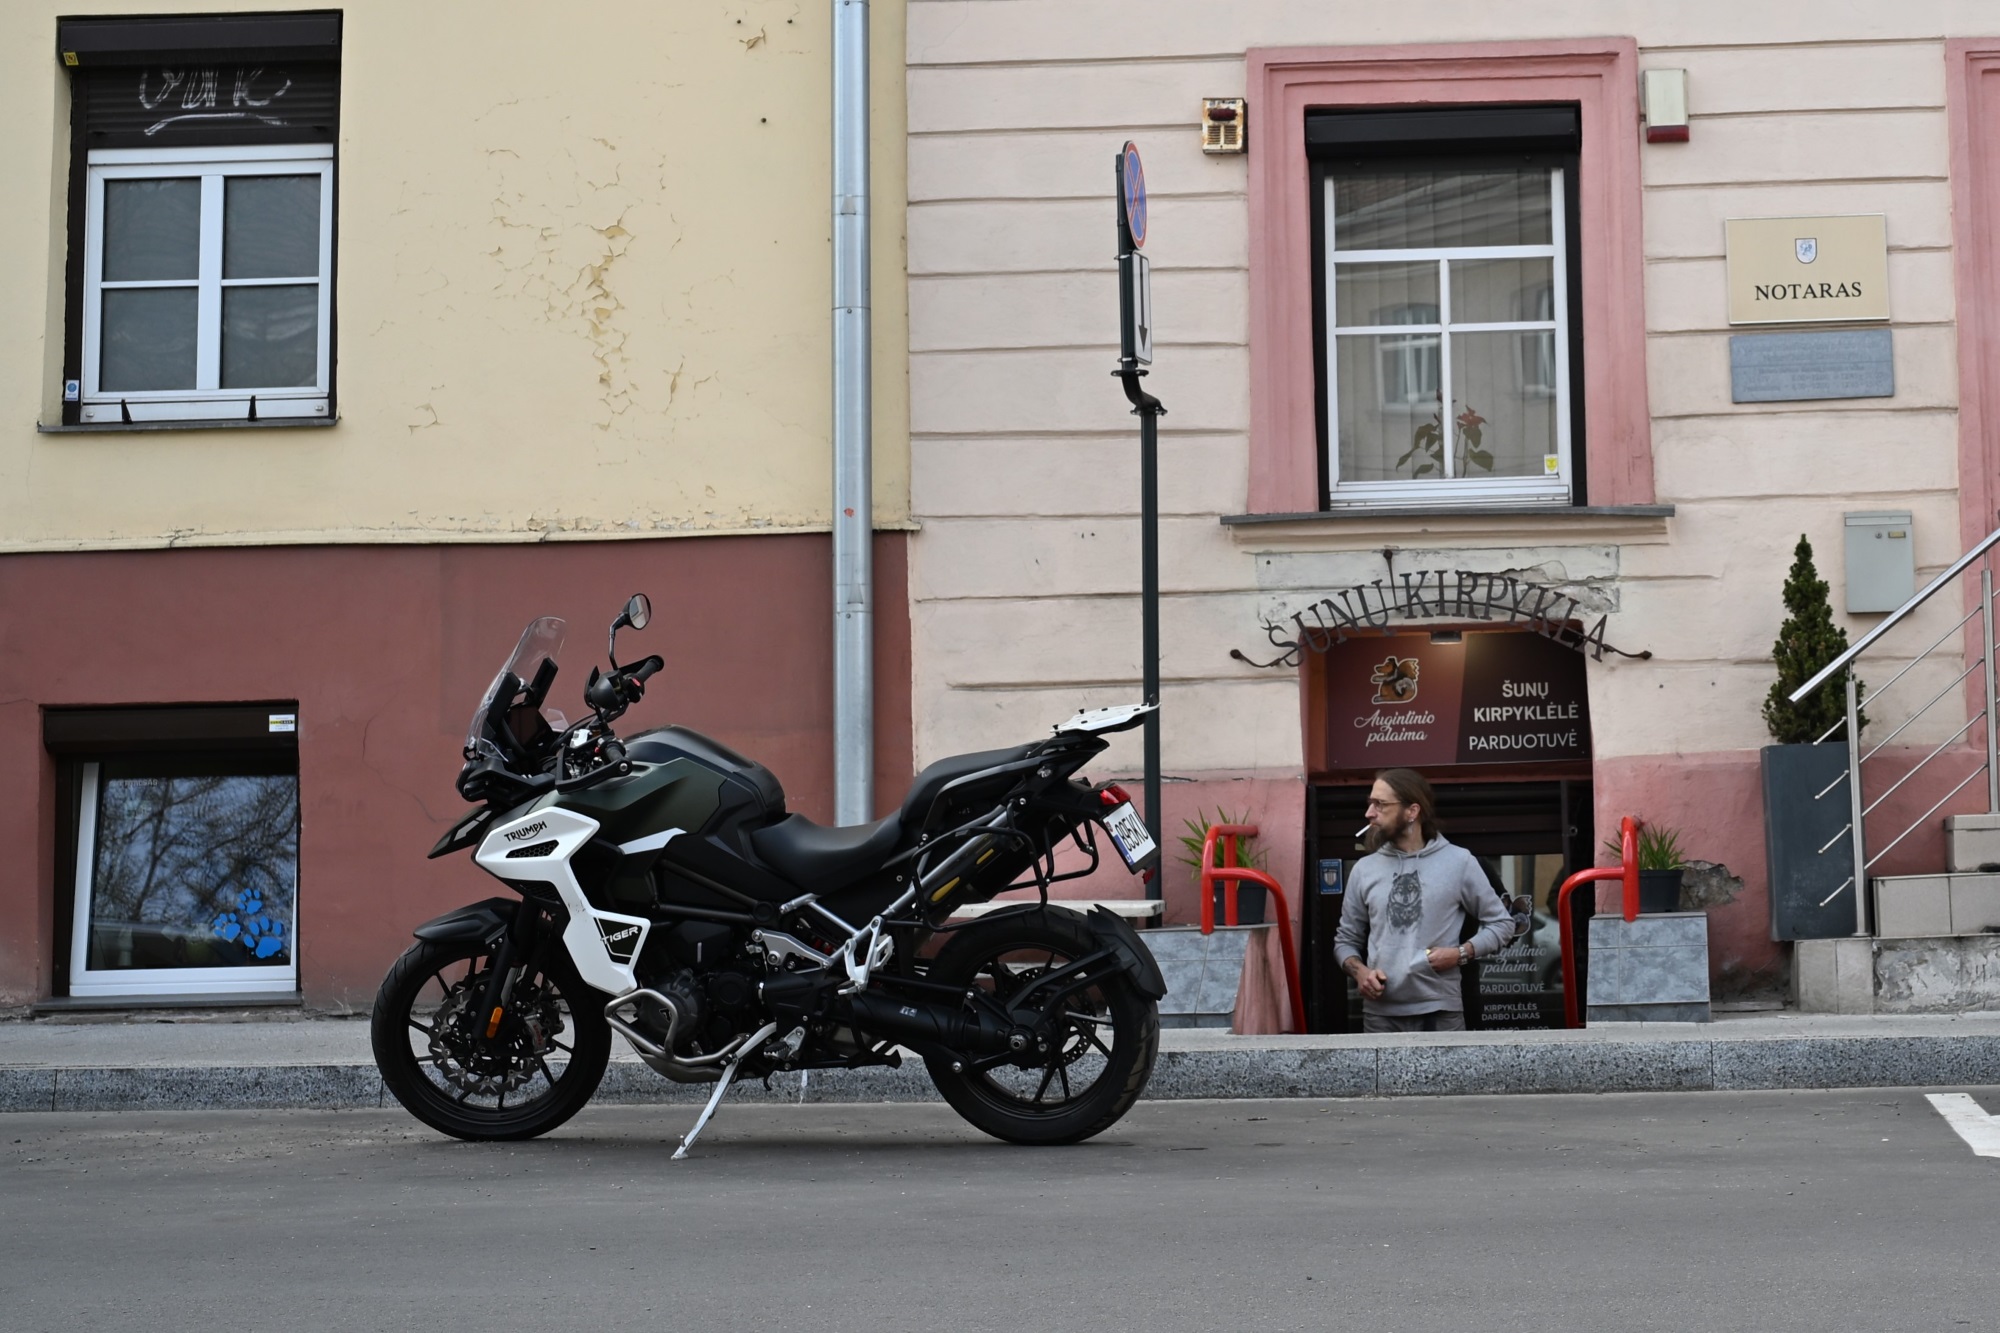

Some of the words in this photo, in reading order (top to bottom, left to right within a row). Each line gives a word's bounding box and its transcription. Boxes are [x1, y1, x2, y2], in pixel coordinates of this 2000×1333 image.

[1754, 281, 1862, 301] NOTARAS
[1399, 569, 1608, 663] KIRPYKLA
[1502, 680, 1549, 700] ŠUNŲ
[1354, 709, 1435, 732] Augintinio
[1474, 701, 1579, 722] KIRPYKLĖLĖ
[1365, 727, 1428, 747] palaima
[1469, 728, 1578, 751] PARDUOTUVĖ
[504, 820, 547, 842] TRIUMPH
[600, 926, 639, 945] TIGER
[1482, 960, 1539, 978] palaima
[1480, 981, 1546, 994] PARDUOTUVĖ
[1481, 1013, 1510, 1021] DARBO
[1511, 1012, 1541, 1020] LAIKAS
[1484, 1002, 1538, 1012] KIRPYKLĖLĖS
